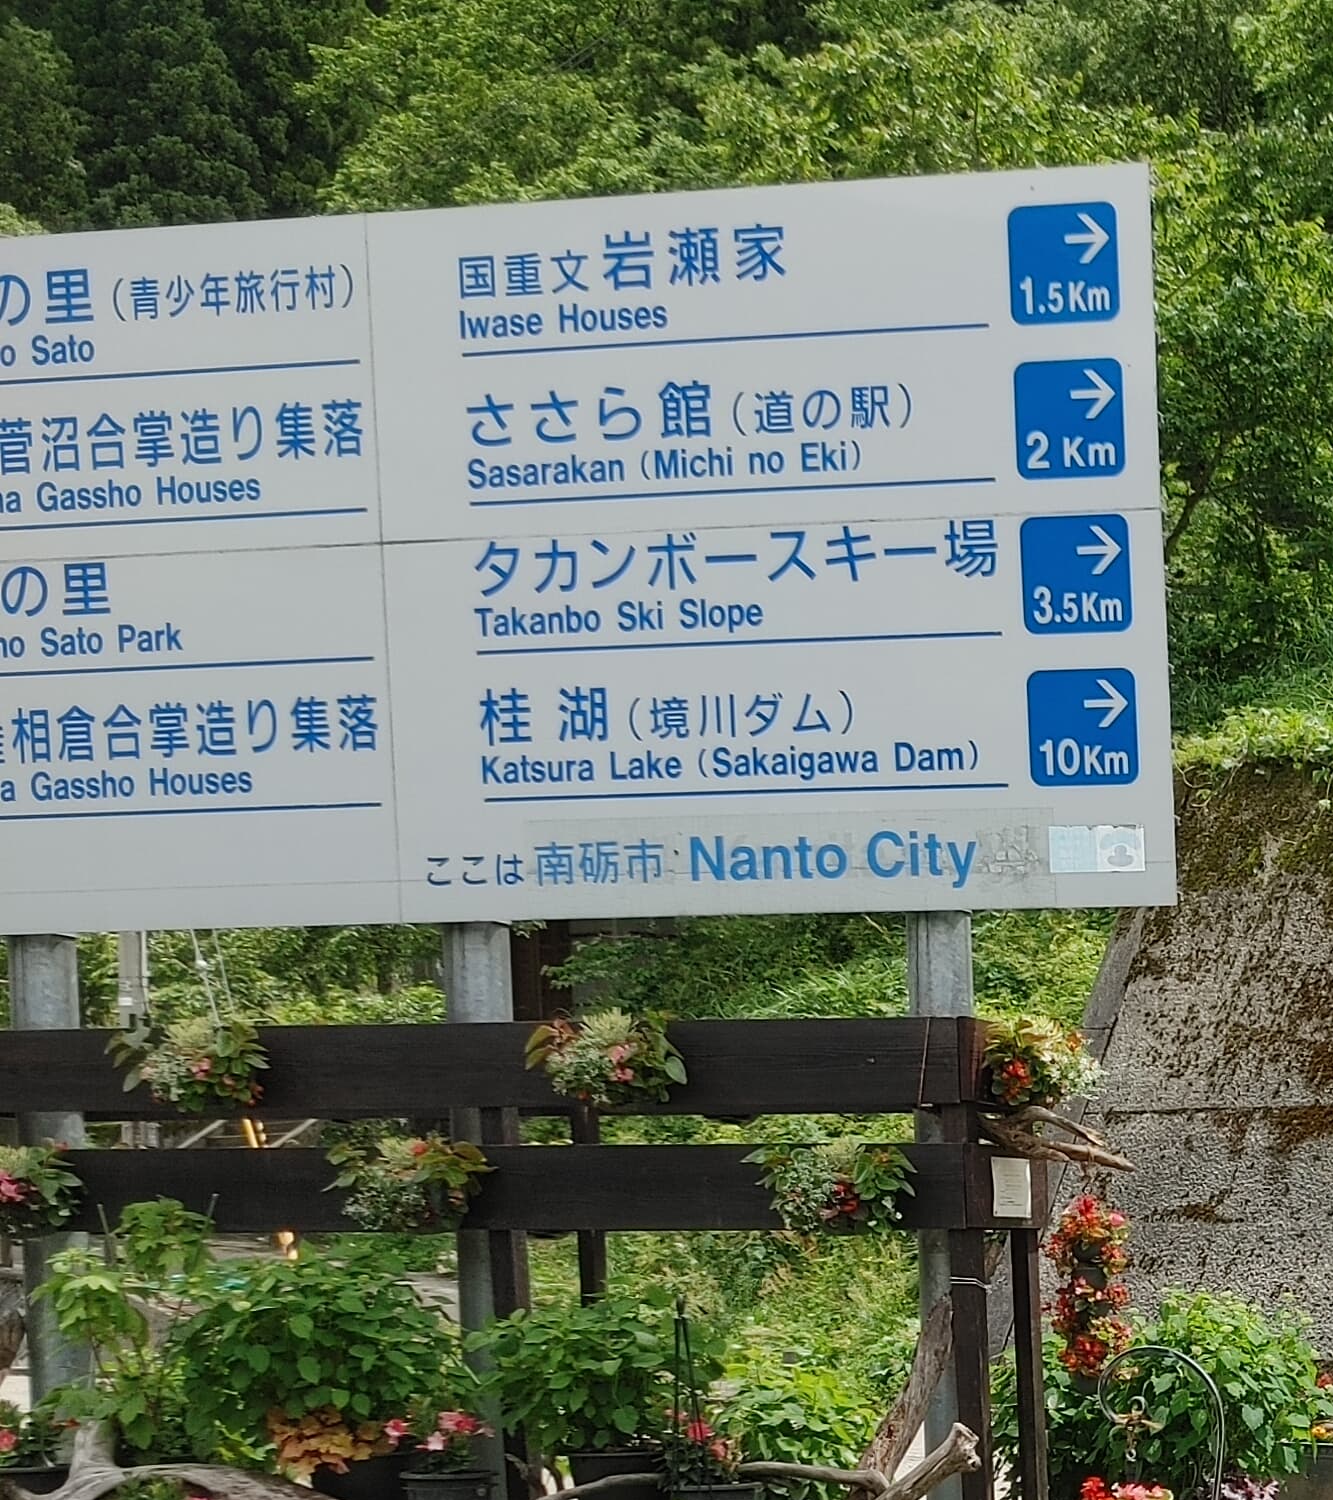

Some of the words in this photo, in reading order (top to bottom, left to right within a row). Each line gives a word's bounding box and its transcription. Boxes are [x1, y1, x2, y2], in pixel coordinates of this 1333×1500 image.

[459, 224, 785, 299] 国重文岩瀬家
[460, 311, 542, 339] Iwase
[559, 304, 667, 333] Houses
[32, 335, 94, 365] Sato
[468, 455, 624, 489] Sasarakan
[641, 447, 732, 480] (Michi
[749, 451, 784, 474] no
[801, 440, 860, 472] Eki)
[1027, 432, 1049, 468] 2
[1064, 438, 1115, 467] Km
[0, 492, 21, 513] a
[37, 480, 141, 512] Gassho
[157, 476, 260, 505] Houses
[475, 520, 998, 596] タカンボースキー場
[1, 562, 110, 616] の里
[474, 605, 600, 636] Takanbo
[618, 601, 663, 632] Ski
[680, 599, 763, 632] Slope
[41, 627, 103, 657] Sato
[118, 623, 182, 652] Park
[0, 694, 377, 764] 相倉合掌造り集落
[482, 755, 594, 784] Katsura
[610, 750, 682, 780] Lake
[699, 746, 878, 780] (Sakaigawa
[894, 741, 977, 771] Dam)
[1040, 739, 1128, 775] 10Km
[31, 770, 134, 801] Gassho
[150, 768, 252, 796] Houses
[690, 836, 847, 881] Nanto
[867, 831, 976, 888] City
